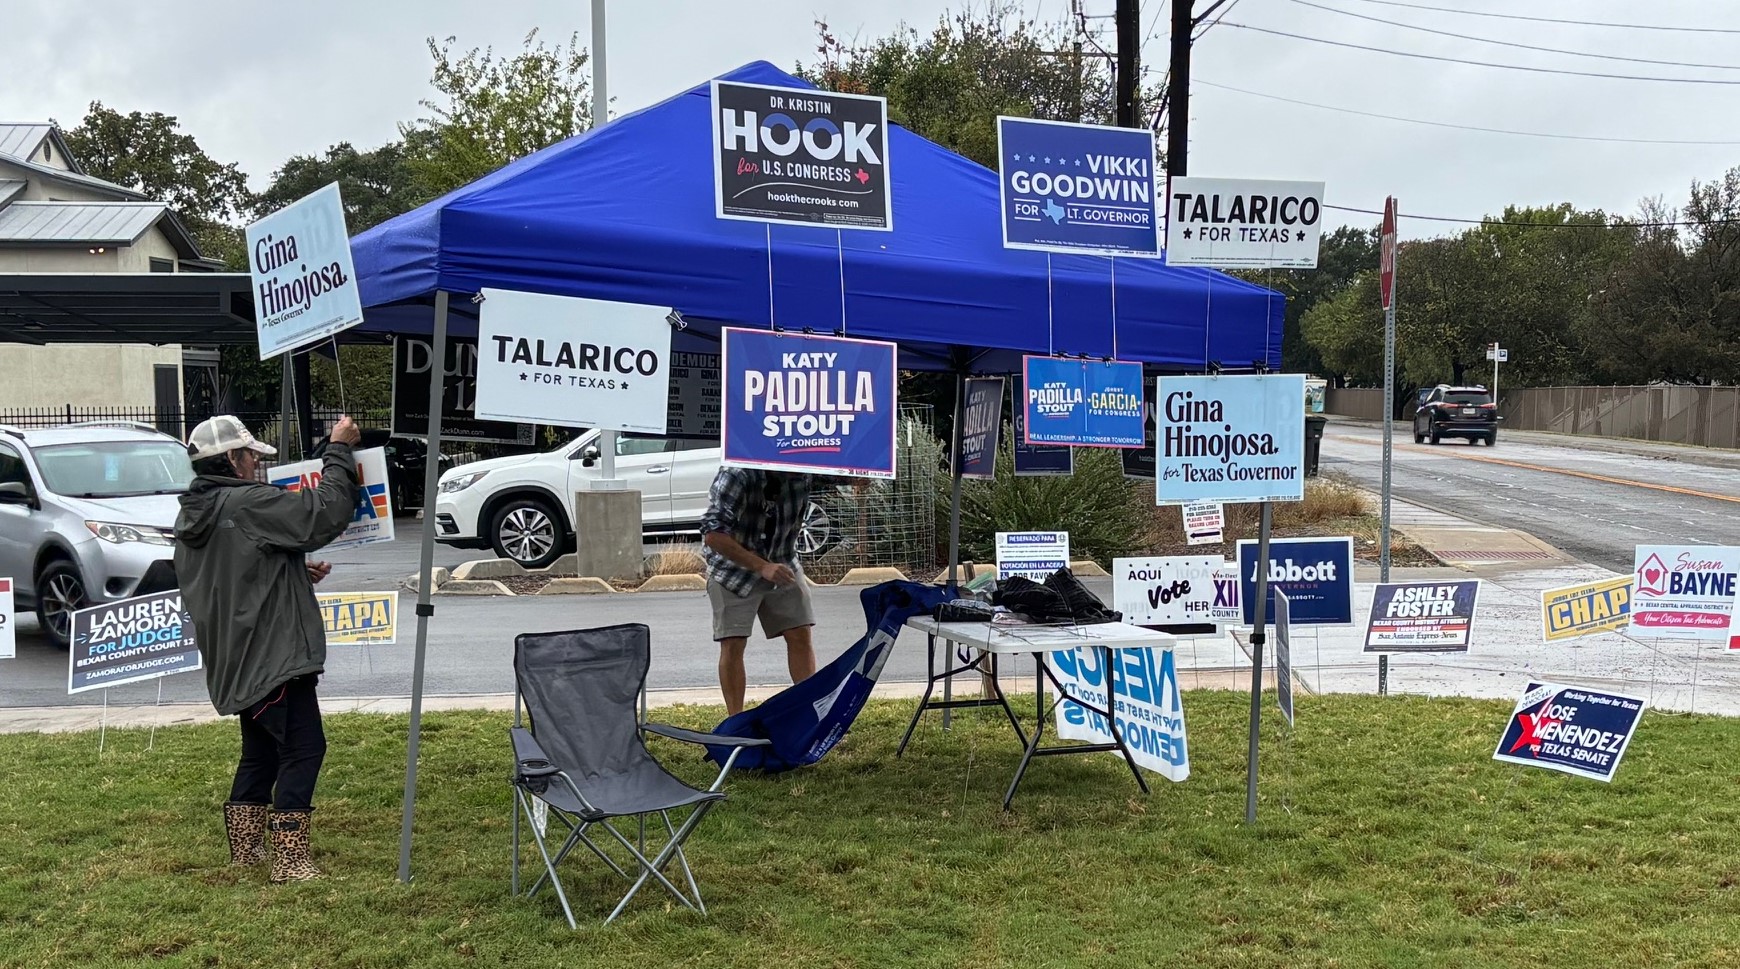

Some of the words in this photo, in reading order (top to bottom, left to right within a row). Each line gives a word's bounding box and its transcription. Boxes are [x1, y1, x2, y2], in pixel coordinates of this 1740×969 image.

[770, 96, 787, 110] DR.
[789, 100, 831, 114] KRISTIN
[722, 108, 882, 165] HOOK
[737, 157, 759, 176] for
[762, 160, 784, 176] U.S.
[787, 162, 851, 182] CONGRESS
[1086, 154, 1147, 177] VIKKI
[1011, 170, 1149, 203] GOODWIN
[1015, 204, 1039, 216] FOR
[1067, 208, 1081, 220] LT.
[1084, 210, 1149, 224] GOVERNOR
[1173, 194, 1319, 226] TALARICO
[1200, 227, 1230, 241] FOR
[1239, 228, 1289, 242] TEXAS
[255, 234, 298, 274] Gina
[492, 335, 658, 376] TALARICO
[782, 352, 838, 368] KATY
[534, 373, 562, 386] FOR
[569, 376, 616, 390] TEXAS
[744, 370, 874, 412] PADILLA
[969, 390, 986, 404] KATY
[1029, 388, 1082, 404] PADILLA
[1092, 392, 1138, 410] GARCIA
[1037, 404, 1074, 413] STOUT
[1104, 410, 1141, 418] CONGRESS
[1165, 391, 1223, 423] Gina
[762, 414, 854, 437] STOUT
[776, 438, 790, 448] For
[791, 438, 842, 448] CONGRESS
[962, 434, 986, 454] STOUT
[1030, 433, 1044, 441] REAL
[1082, 436, 1110, 444] STRONGER
[1163, 466, 1180, 480] for
[1182, 463, 1224, 482] Texas
[1226, 462, 1298, 481] Governor
[1674, 552, 1724, 572] Susan
[1128, 566, 1162, 582] AQUÍ
[1670, 572, 1737, 596] BAYNE
[1148, 580, 1192, 610] Vote
[1392, 586, 1458, 602] ASHLEY
[90, 596, 182, 630] LAUREN
[320, 601, 388, 631] HAPA
[1184, 601, 1209, 612] HER
[1212, 610, 1239, 618] COUNTY
[1386, 600, 1456, 618] FOSTER
[1552, 588, 1628, 630] CHAP
[89, 612, 182, 644] ZAMORA
[1415, 618, 1440, 626] DISTRICT
[1644, 613, 1660, 624] Your
[1660, 613, 1682, 624] Citizen
[1682, 614, 1693, 624] Tax
[1694, 614, 1724, 624] Advocate
[88, 642, 116, 656] FOR
[118, 626, 182, 650] JUDGE
[1378, 632, 1390, 640] San
[1390, 632, 1414, 640] Antonio
[1416, 631, 1458, 640] Express-News
[77, 652, 106, 667] BEXAR
[108, 646, 148, 660] COUNTY
[148, 640, 182, 652] COURT
[184, 638, 194, 646] 12
[86, 655, 184, 680] ZAMORAFORJUDGE.COM
[1564, 692, 1587, 702] Working
[1587, 695, 1612, 707] Together
[1612, 698, 1621, 706] for
[1622, 700, 1640, 710] Texas
[1542, 704, 1578, 722] JOSE
[1532, 722, 1625, 754] MENENDEZ
[1529, 744, 1542, 752] FOR
[1542, 744, 1570, 758] TEXAS
[1570, 747, 1610, 766] SENATE
